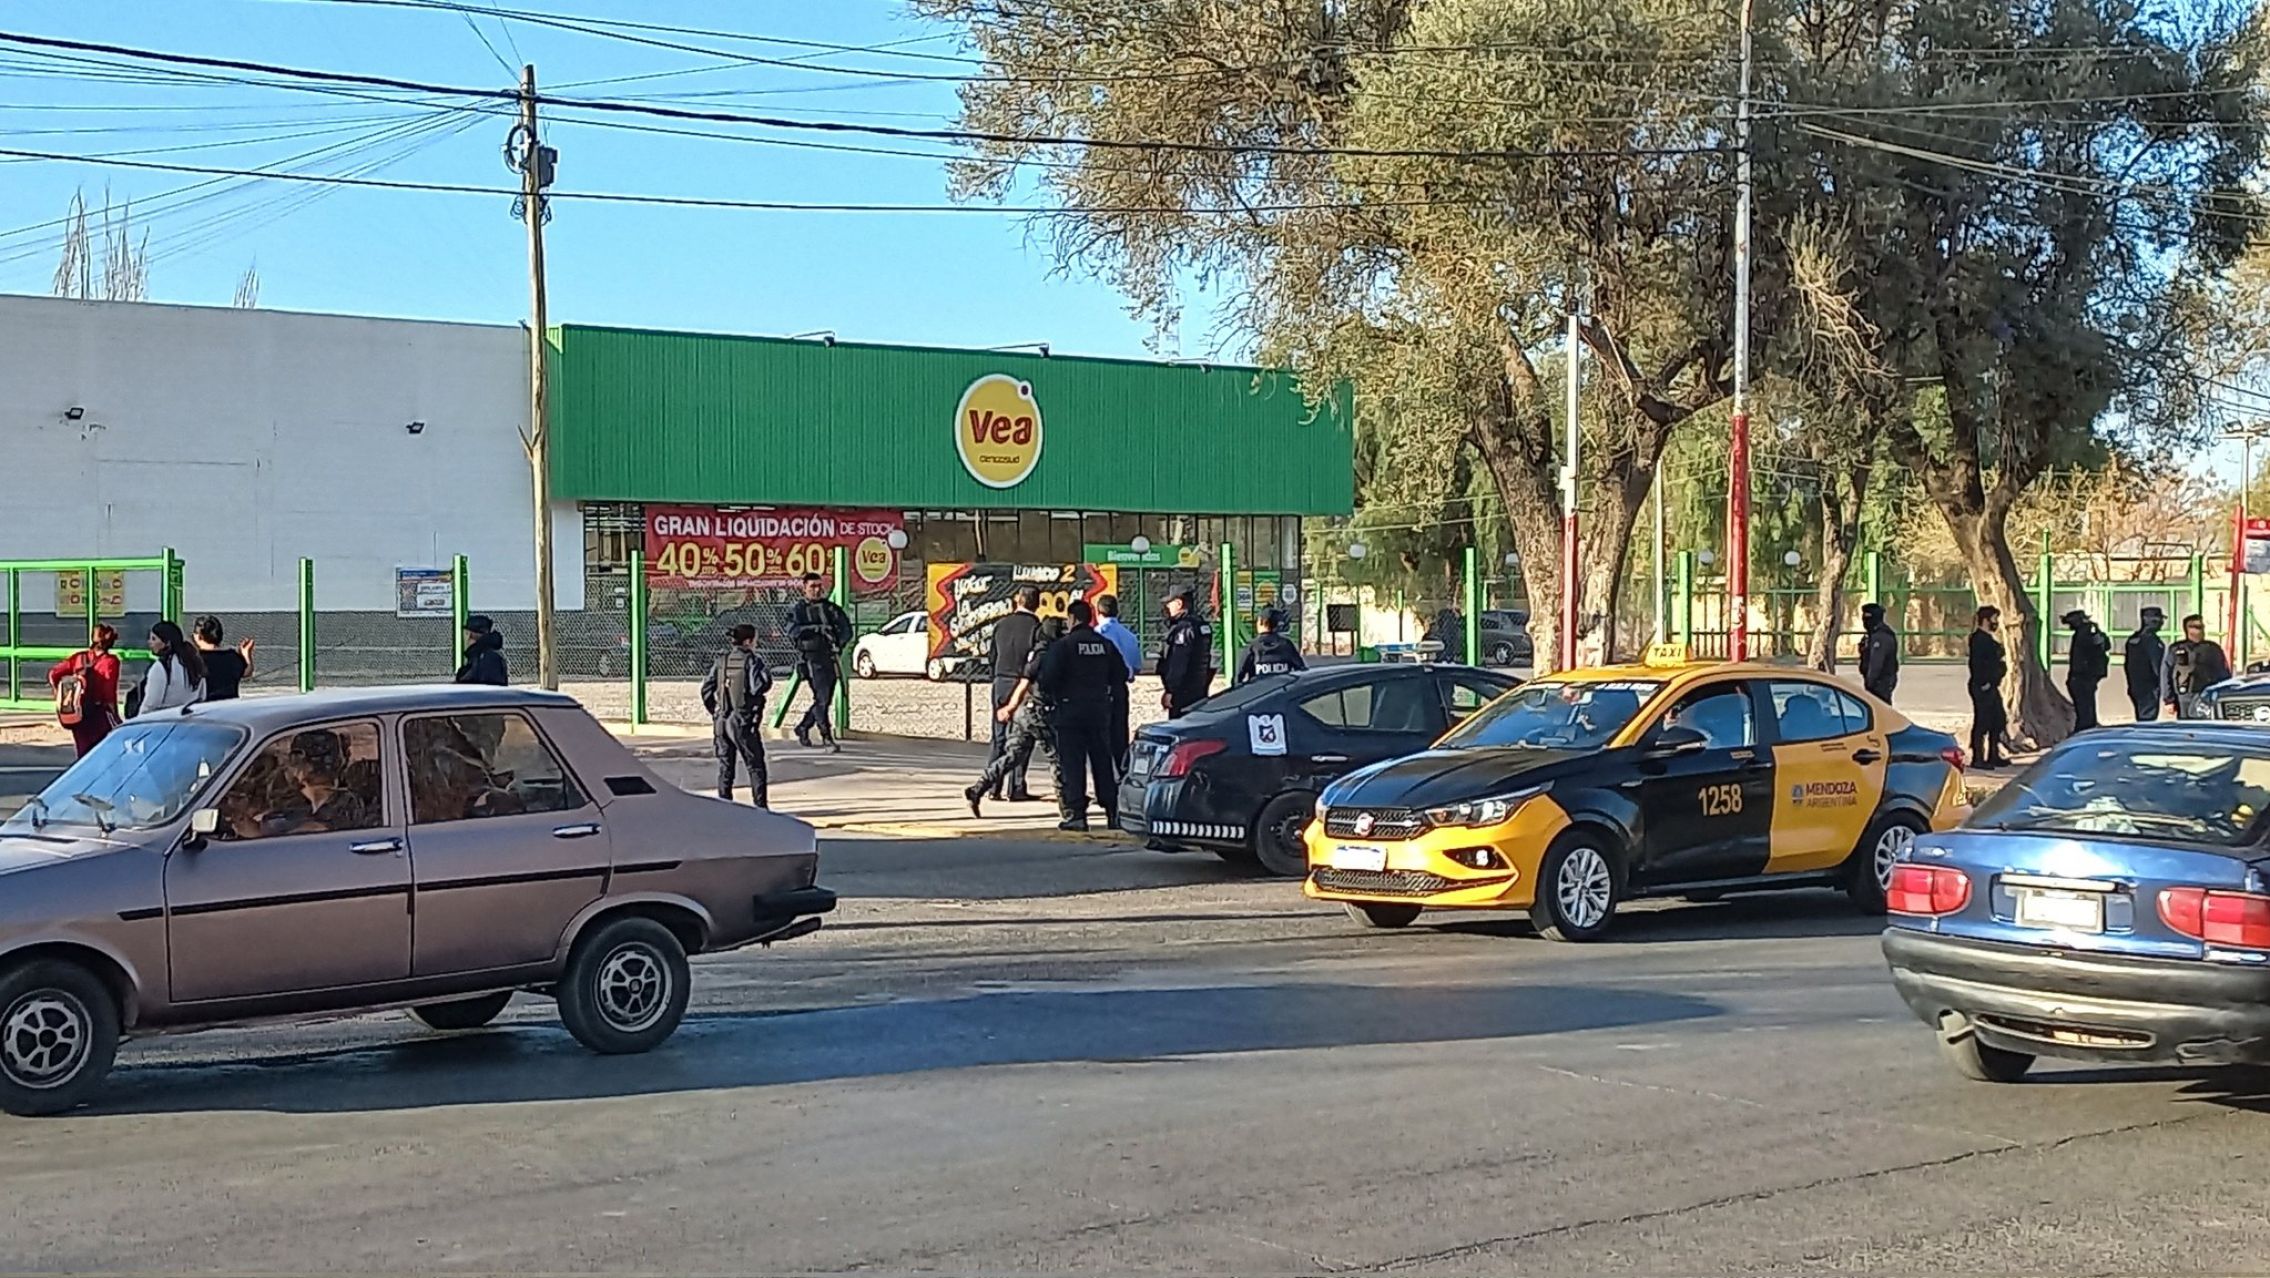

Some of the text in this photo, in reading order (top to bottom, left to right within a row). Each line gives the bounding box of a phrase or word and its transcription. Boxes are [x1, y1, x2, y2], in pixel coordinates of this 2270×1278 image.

[968, 409, 1033, 445] Vea
[654, 513, 895, 538] GRAN LIQUIDACIÓN DE STOCK
[657, 542, 720, 578] 40%
[723, 543, 782, 577] 50%
[862, 549, 887, 564] Vea
[1060, 564, 1076, 582] 2
[1654, 647, 1681, 658] TAXI
[1805, 781, 1858, 796] MENDOZA
[1698, 784, 1742, 816] 1258
